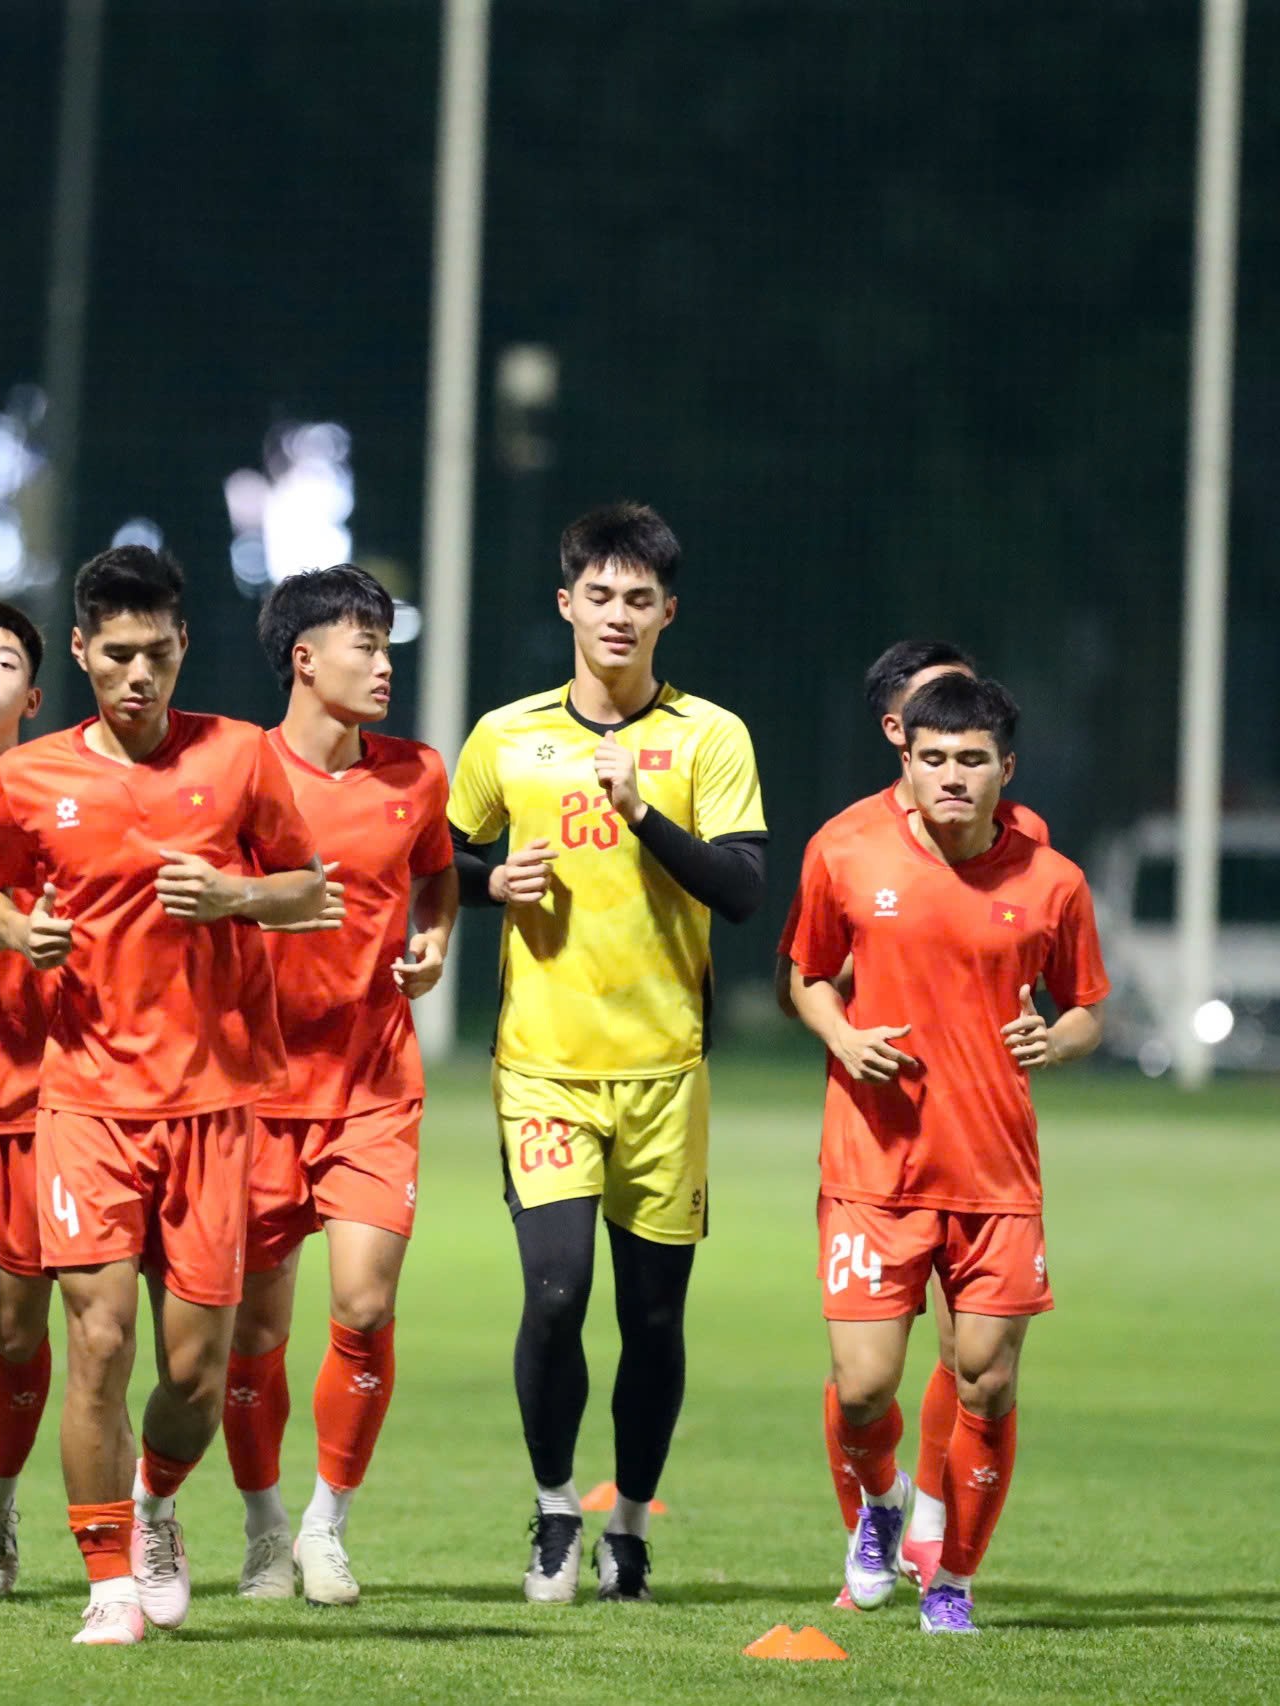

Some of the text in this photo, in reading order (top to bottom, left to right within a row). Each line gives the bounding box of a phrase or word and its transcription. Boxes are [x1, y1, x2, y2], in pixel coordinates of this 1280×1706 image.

[561, 791, 619, 851] 23
[520, 1117, 574, 1174] 23
[52, 1174, 80, 1238] 4
[827, 1232, 882, 1296] 24
